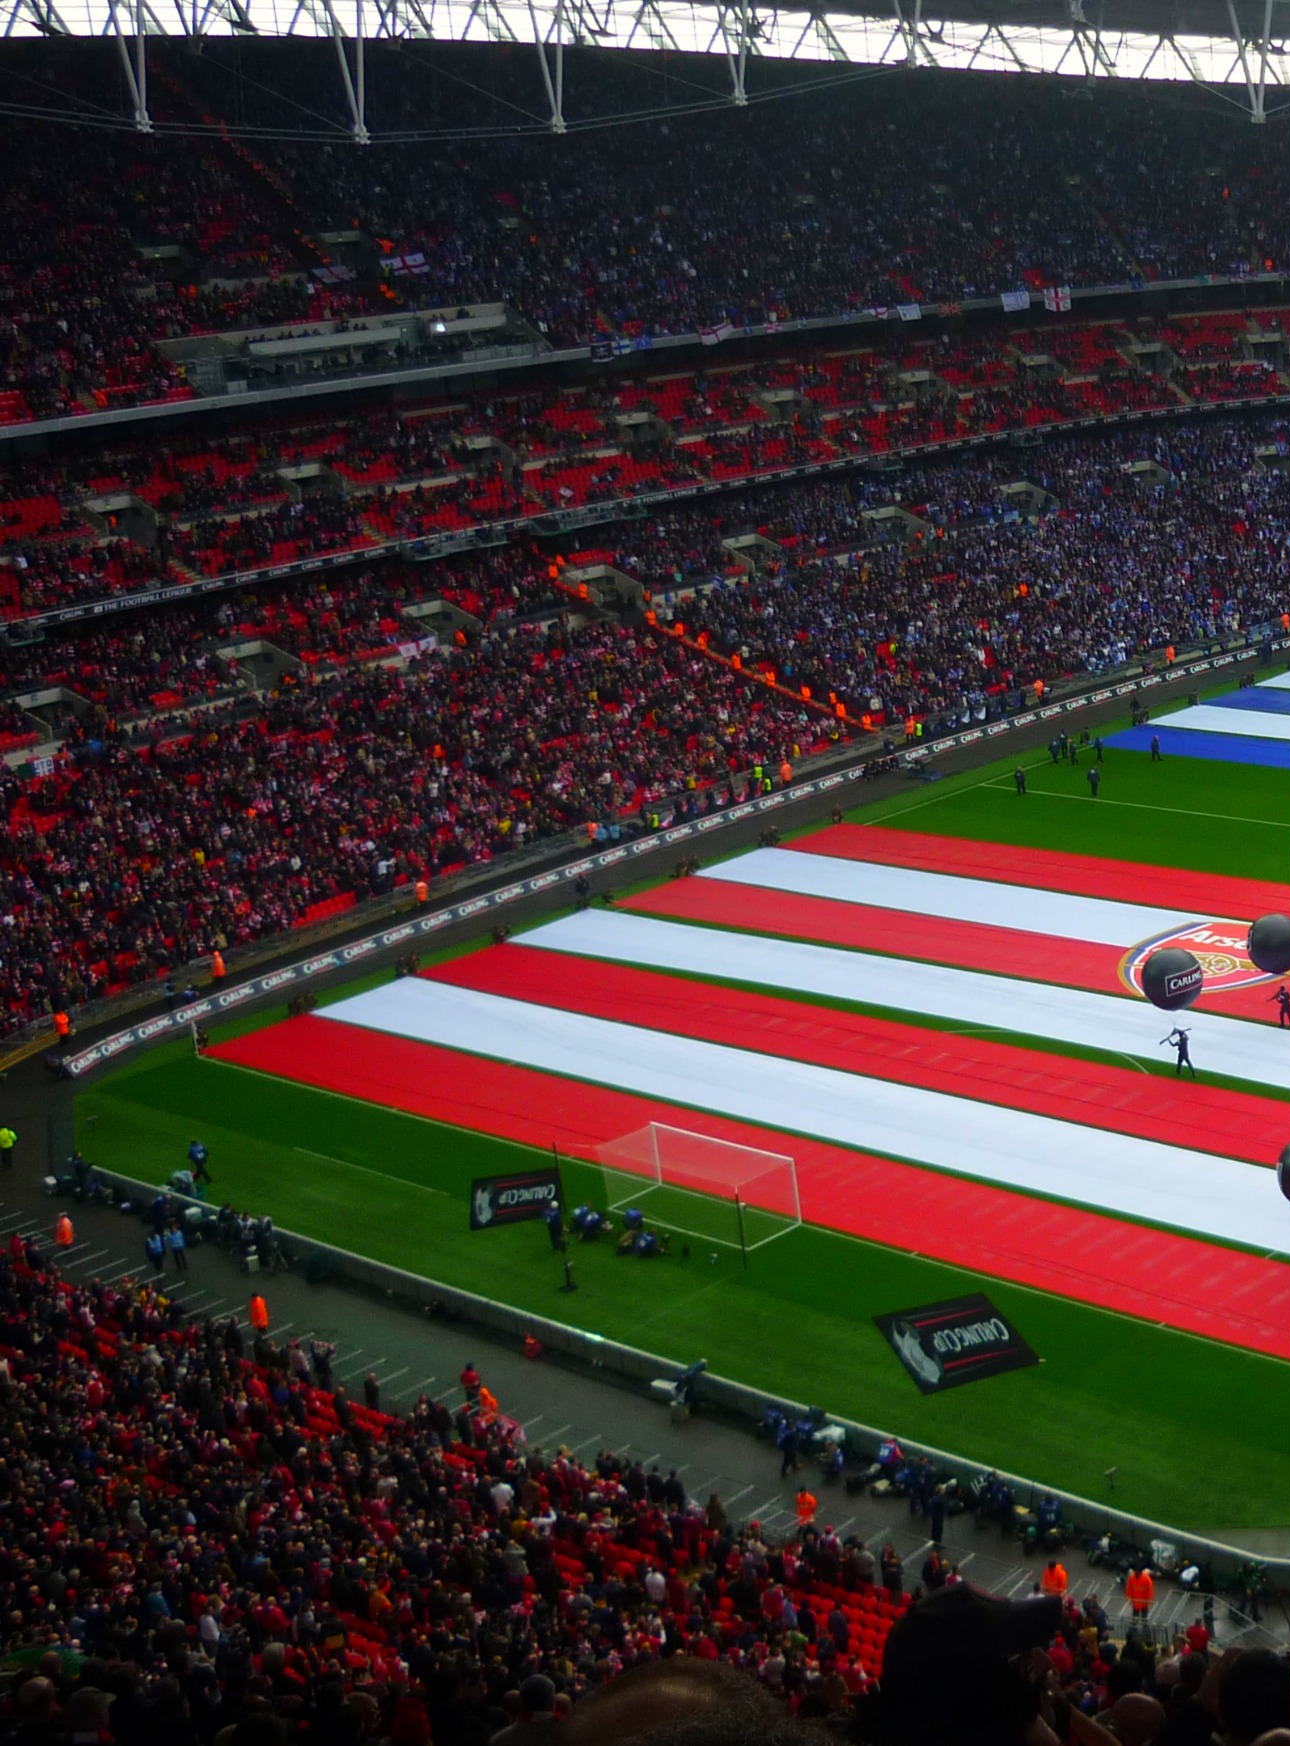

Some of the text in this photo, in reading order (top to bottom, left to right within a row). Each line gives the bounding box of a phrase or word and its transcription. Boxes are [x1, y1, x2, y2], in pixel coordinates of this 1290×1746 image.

[103, 588, 192, 612] THE FOOTBALL LEAGUE
[531, 872, 560, 890] CARLING
[495, 884, 525, 902] CARLING
[460, 898, 490, 916] CARLING
[421, 910, 452, 930] CARLING
[384, 925, 415, 944] CARLING
[344, 939, 377, 959] CARLING
[303, 954, 337, 974] CARLING
[262, 969, 296, 990] CARLING
[220, 984, 254, 1006] CARLING
[176, 1001, 212, 1023] CARLING
[138, 1016, 173, 1038] CARLING
[102, 1032, 134, 1057] CARLING
[71, 1048, 100, 1073] CARLING
[498, 1184, 556, 1205] CARLING CUP
[933, 1318, 1010, 1352] CARLING CUP
